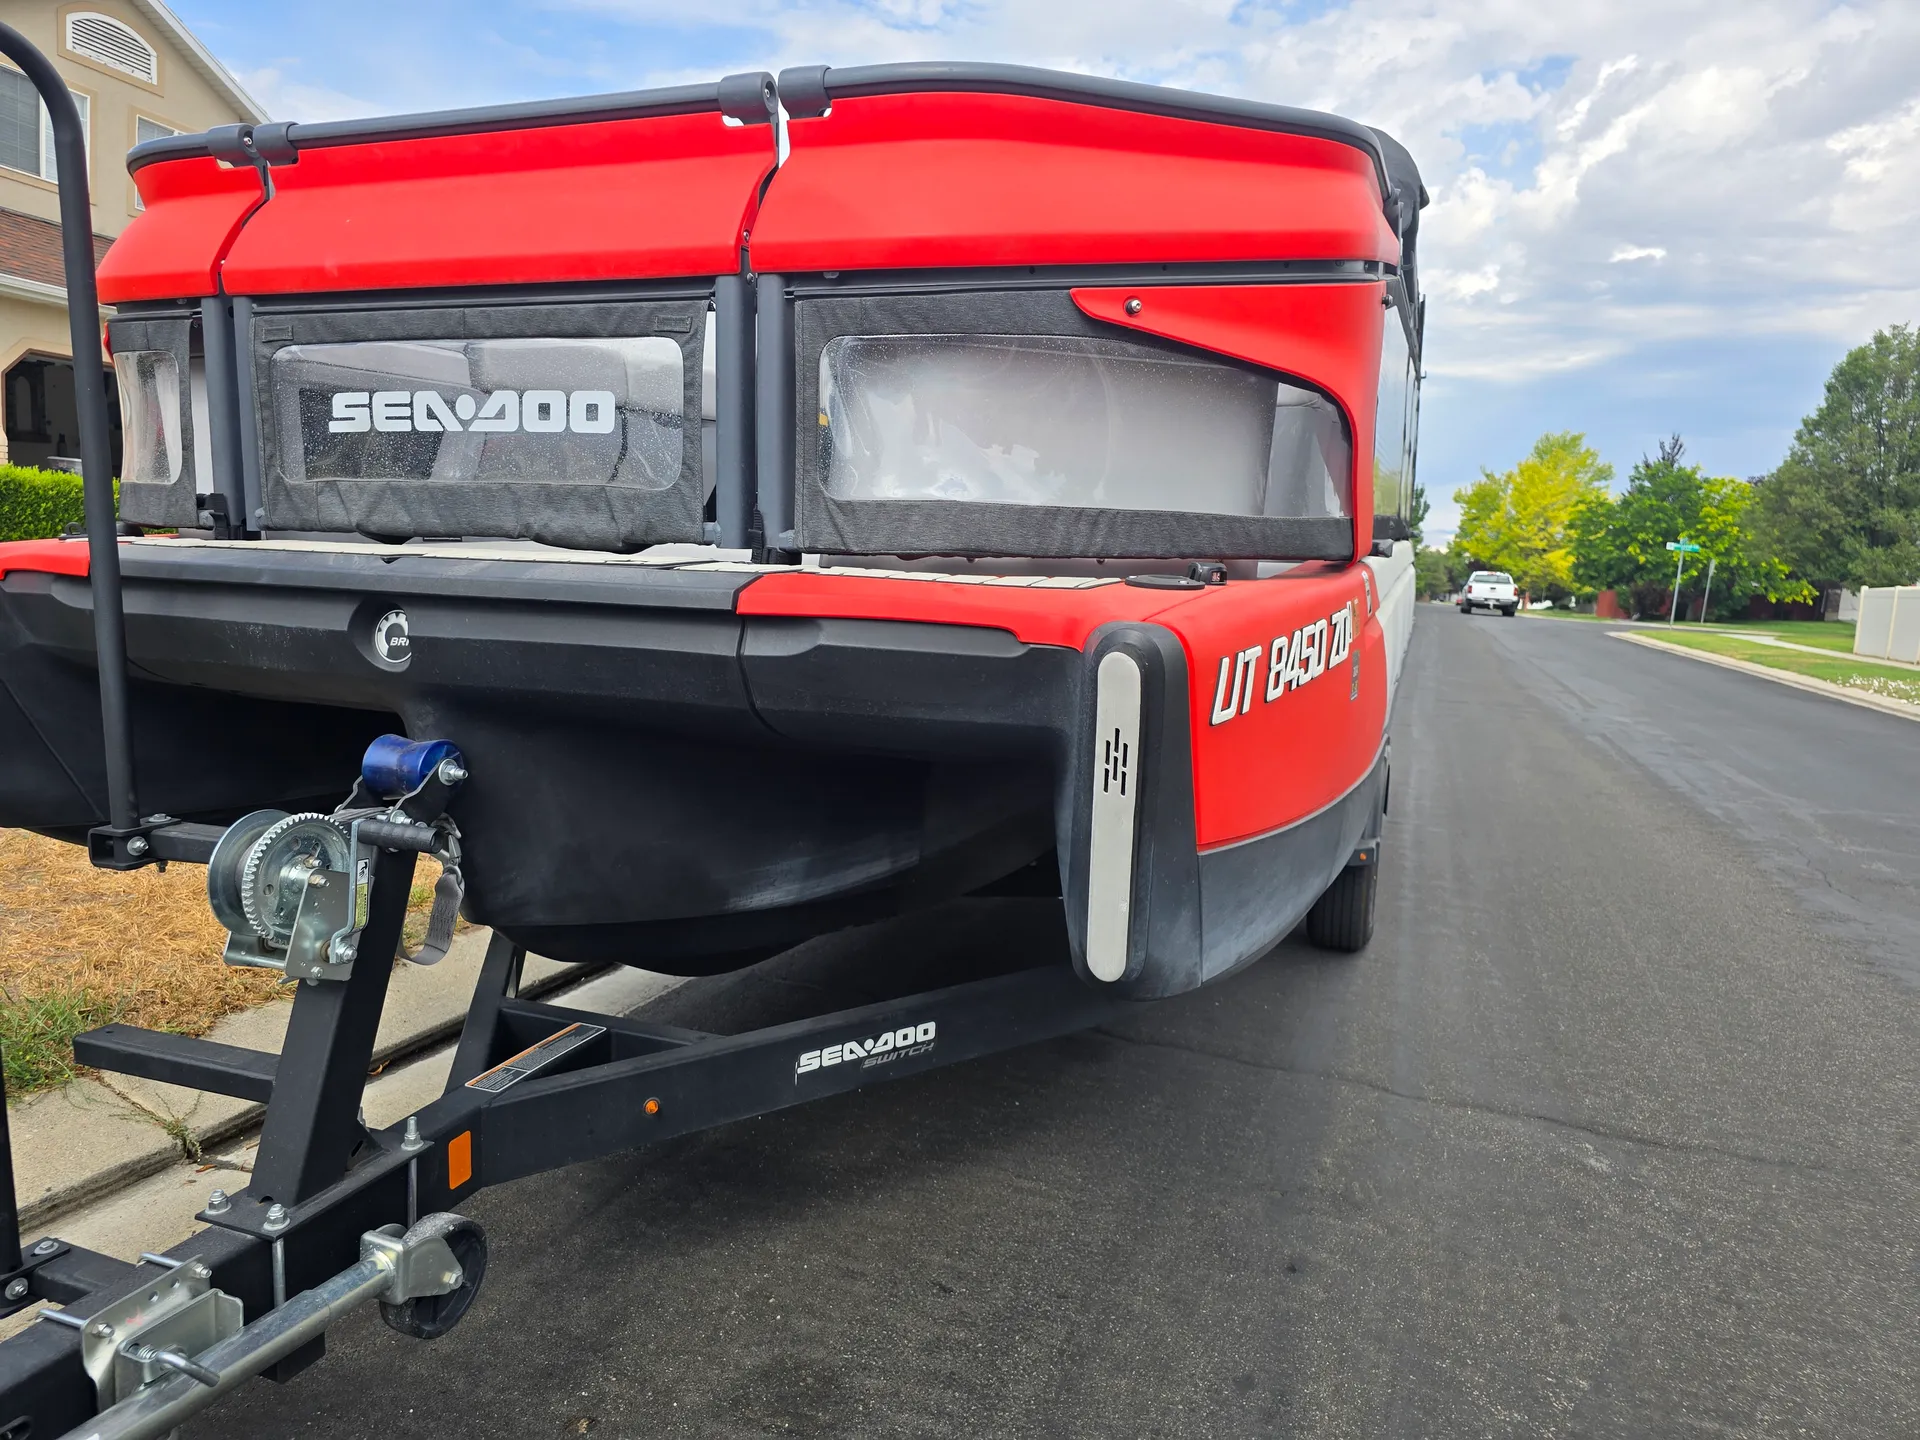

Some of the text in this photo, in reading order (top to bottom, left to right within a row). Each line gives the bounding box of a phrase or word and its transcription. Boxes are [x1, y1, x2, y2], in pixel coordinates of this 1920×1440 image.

[1209, 645, 1263, 726] UT
[1264, 618, 1328, 703] 8450
[862, 1042, 935, 1069] SWITCH
